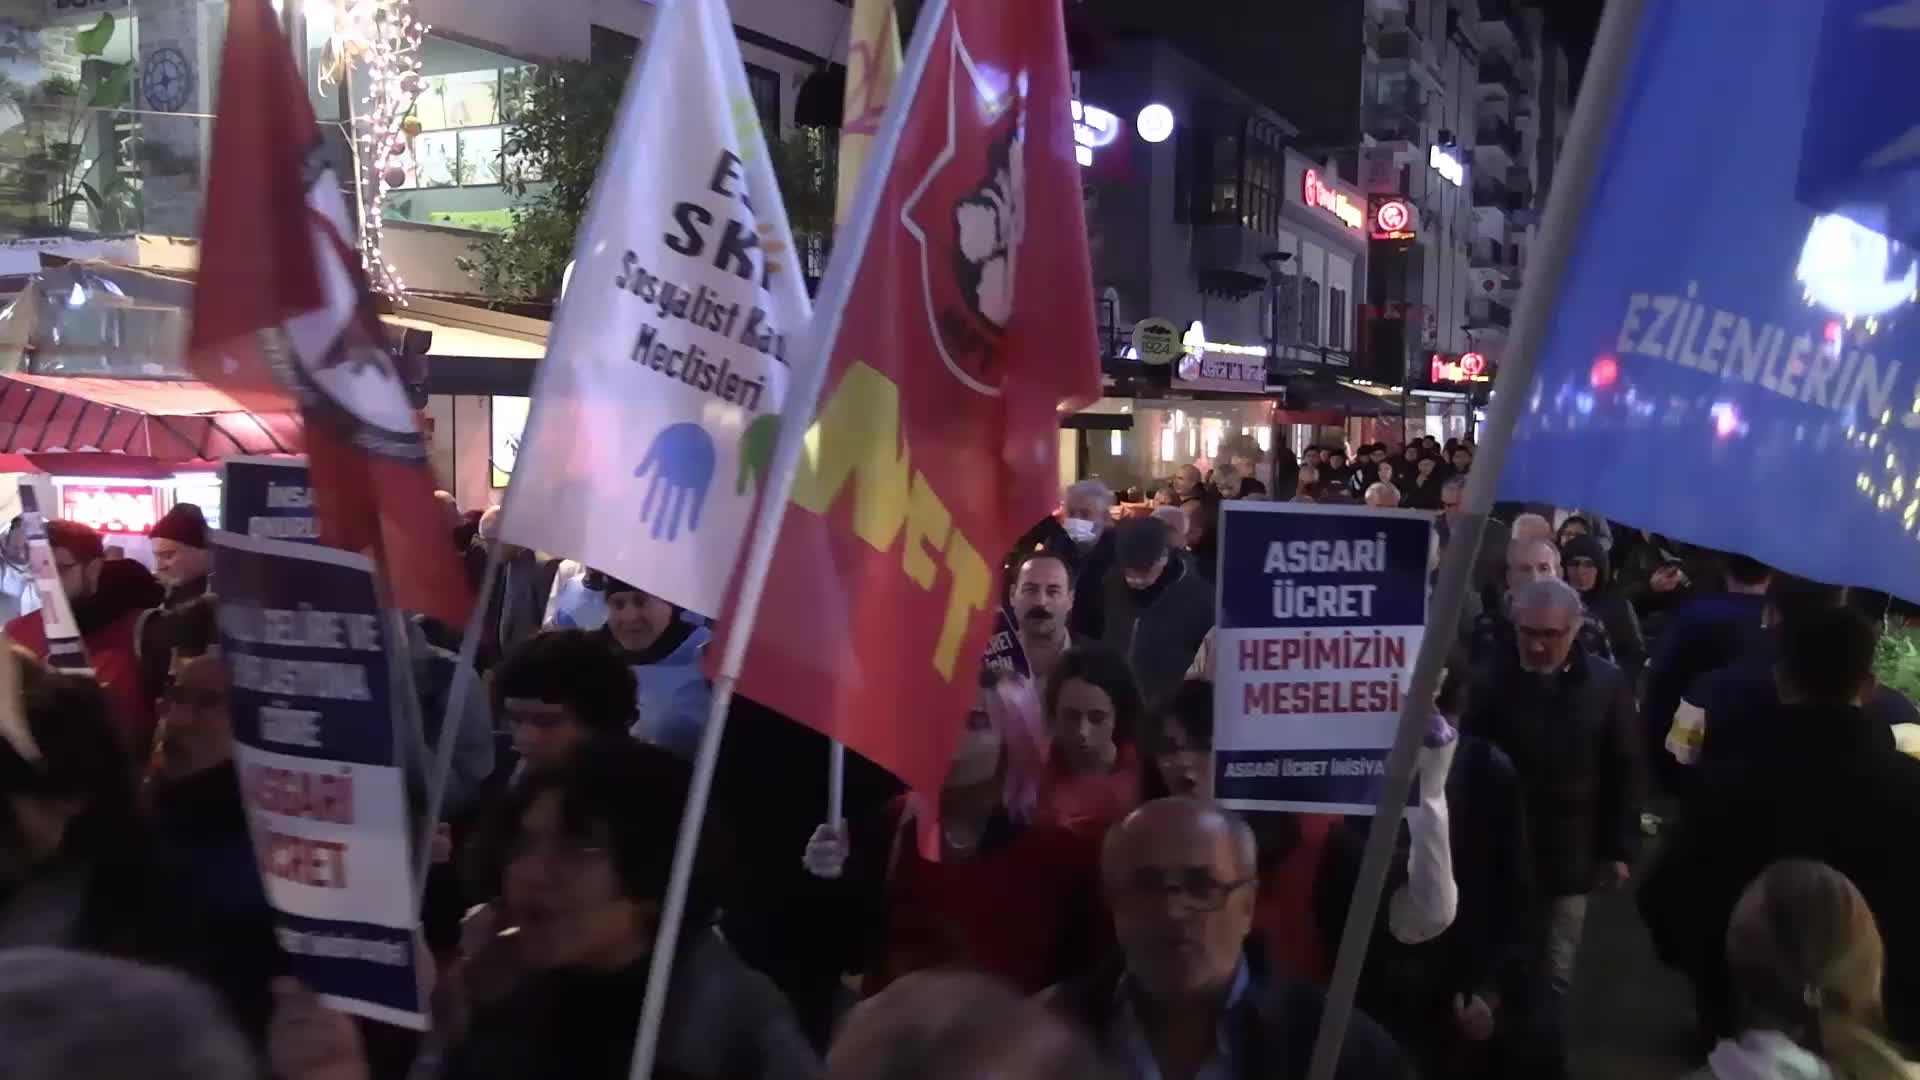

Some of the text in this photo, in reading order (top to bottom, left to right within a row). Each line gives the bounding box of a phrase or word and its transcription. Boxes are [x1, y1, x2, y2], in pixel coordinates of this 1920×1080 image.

[614, 250, 738, 338] Sosyalist
[630, 322, 766, 411] Meclisleri
[1263, 532, 1387, 573] ASGARİ
[1272, 580, 1377, 619] ÜCRET
[1238, 630, 1406, 672] HEPİMİZİN
[1243, 673, 1401, 715] MESELESİ
[1281, 757, 1329, 778] ÜCRET
[1331, 755, 1386, 776] İNİSİYA
